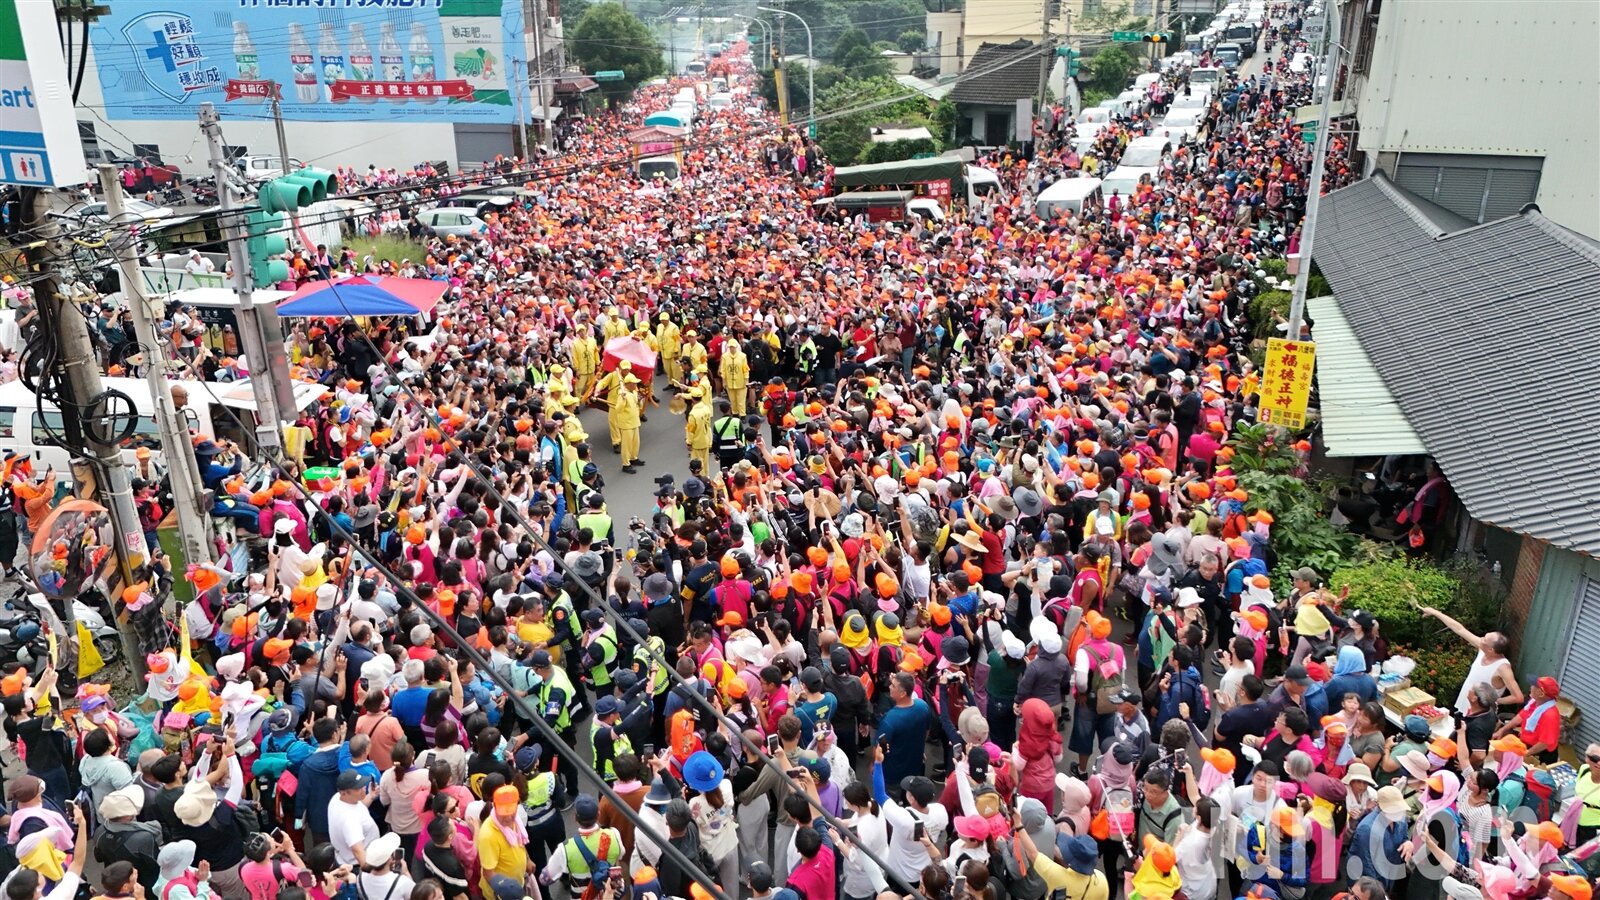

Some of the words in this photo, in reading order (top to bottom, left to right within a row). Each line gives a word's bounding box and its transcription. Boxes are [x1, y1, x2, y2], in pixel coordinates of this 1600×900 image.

[0, 86, 34, 108] art
[1274, 354, 1298, 408] 福德正神
